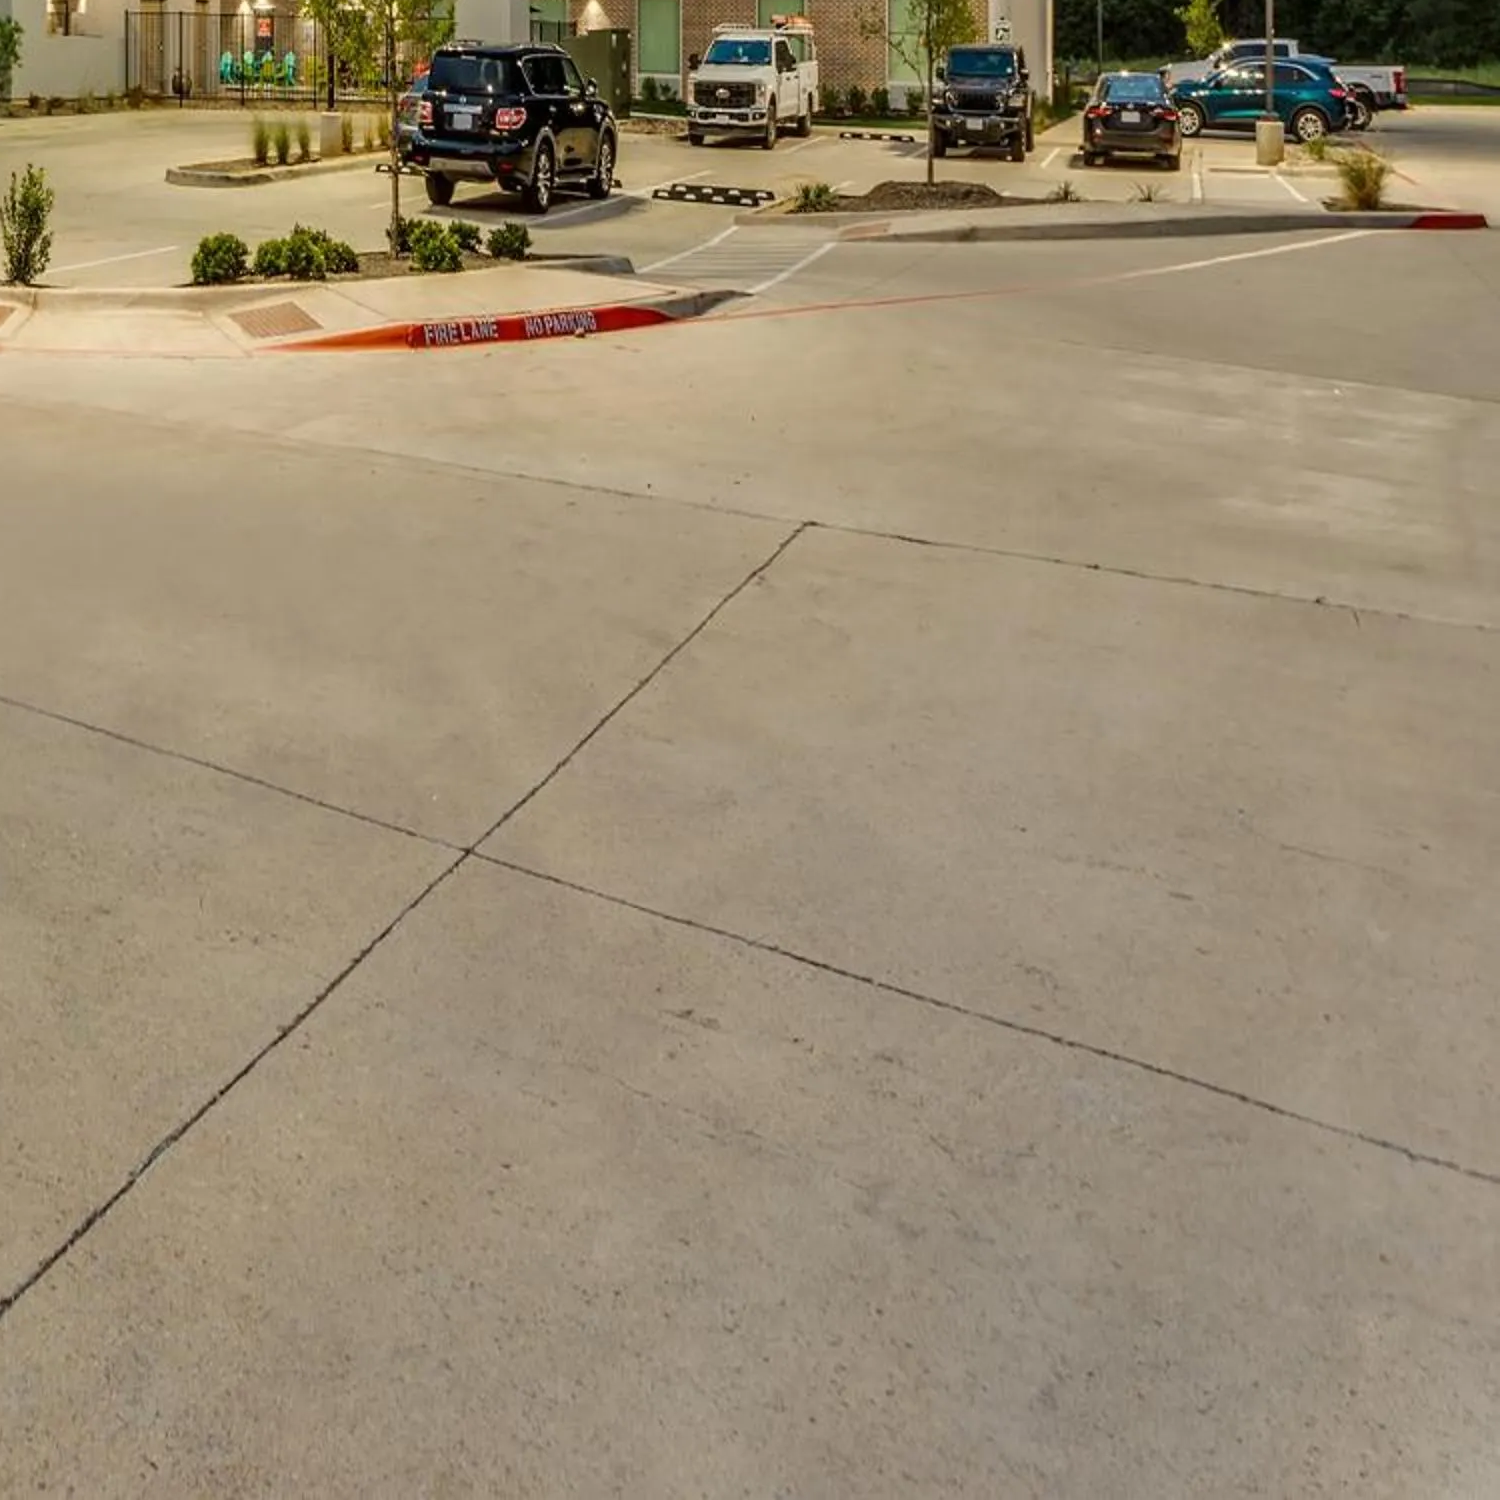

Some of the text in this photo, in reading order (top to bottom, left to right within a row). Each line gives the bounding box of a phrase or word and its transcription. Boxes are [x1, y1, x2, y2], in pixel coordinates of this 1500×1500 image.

[423, 318, 499, 347] FIRE LANE
[523, 311, 597, 338] NO PARKING
